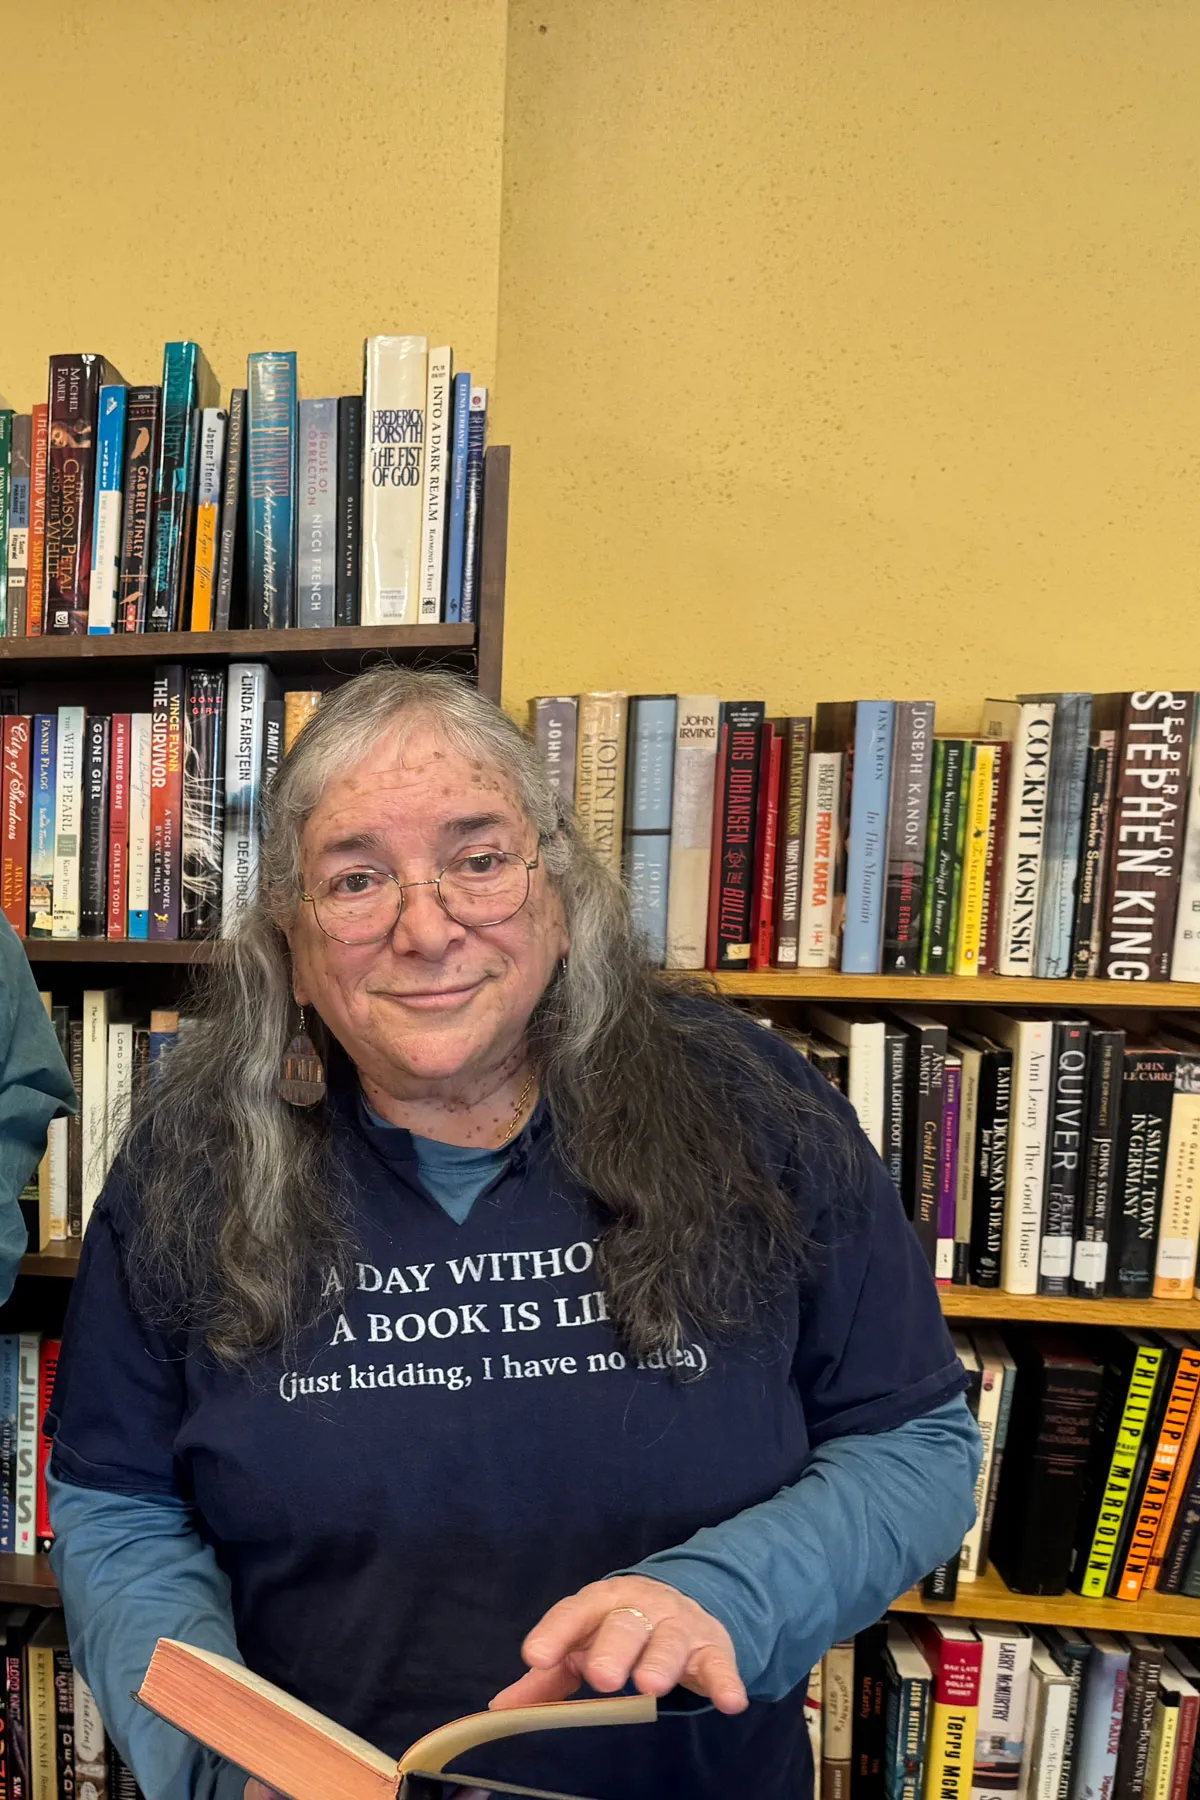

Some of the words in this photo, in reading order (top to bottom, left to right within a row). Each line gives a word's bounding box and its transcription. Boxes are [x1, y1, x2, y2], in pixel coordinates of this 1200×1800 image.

[56, 367, 68, 403] FABER
[69, 367, 81, 412] MICHEL
[432, 384, 443, 419] INTO
[229, 395, 241, 454] ANTONIA
[372, 409, 423, 425] FREDERICK
[372, 425, 423, 443] FORSYTH
[432, 422, 441, 431] A
[204, 427, 217, 460] Jasper
[371, 447, 395, 466] THE
[398, 447, 422, 466] FIST
[430, 435, 441, 472] DARK
[51, 466, 61, 493] AND
[135, 465, 149, 514] GABRIEL
[204, 462, 215, 494] Fforde
[226, 459, 238, 506] FRASER
[372, 467, 389, 486] OF
[391, 466, 419, 486] GOD
[50, 496, 61, 519] THE
[61, 459, 79, 538] CRIMSON
[428, 477, 440, 521] REALM
[47, 520, 61, 579] WHITE
[133, 519, 147, 559] FINLEY
[311, 514, 322, 553] NICCI
[59, 543, 76, 594] PETAL
[310, 558, 322, 611] FRENCH
[153, 678, 168, 707] THE
[169, 694, 180, 731] VINCE
[239, 675, 254, 713] LINDA
[5, 723, 27, 759] City
[40, 719, 51, 755] FANNIE
[116, 722, 124, 734] AN
[266, 720, 279, 764] FAMILY
[680, 728, 716, 738] IRVING
[682, 716, 714, 726] JOHN
[909, 708, 927, 774] JOSEPH
[62, 733, 75, 780] WHITE
[92, 723, 102, 764] GONE
[114, 736, 124, 781] UNMARKED
[151, 719, 168, 788] SURVIVOR
[168, 733, 180, 772] FLYNN
[234, 717, 252, 781] FAIRSTEIN
[732, 731, 755, 761] IRIS
[6, 761, 23, 777] of
[39, 757, 51, 790] FLAGG
[91, 769, 102, 800] GIRL
[1018, 719, 1051, 845] COCKPIT
[1116, 690, 1174, 873] STEPHEN
[1154, 700, 1187, 878] DESPERATION
[8, 779, 27, 841] Shadows
[62, 784, 74, 832] PEARL
[114, 784, 123, 810] GRAVE
[726, 767, 753, 844] JOHANSEN
[904, 783, 921, 846] KANON
[154, 825, 162, 838] BY
[154, 840, 162, 865] KYLE
[163, 818, 172, 848] MITCH
[815, 812, 832, 858] FRANZ
[3, 857, 13, 909] FRANKLIN
[14, 865, 23, 903] ARIANA
[112, 842, 122, 885] CHARLES
[163, 851, 171, 877] RAPP
[812, 861, 830, 907] KAFKA
[112, 888, 121, 915] TODD
[162, 878, 170, 910] NOVEL
[720, 887, 745, 941] BULLET
[1008, 853, 1038, 964] KOSINSKI
[1107, 890, 1156, 981] KING
[918, 1044, 932, 1096] LAMOTT
[931, 1052, 944, 1089] ANNE
[1028, 1050, 1045, 1081] Ann
[995, 1066, 1009, 1112] EMILY
[1022, 1088, 1042, 1130] Leary
[1052, 1050, 1086, 1170] QUIVER
[1131, 1114, 1146, 1131] IN
[989, 1118, 1007, 1192] DICKINSON
[1024, 1142, 1040, 1171] The
[1142, 1129, 1161, 1184] SMALL
[1022, 1176, 1038, 1215] Good
[1122, 1135, 1144, 1219] GERMANY
[989, 1197, 1003, 1210] IS
[1138, 1186, 1157, 1239] TOWN
[987, 1212, 1001, 1252] DEAD
[1019, 1221, 1037, 1268] House
[321, 1266, 343, 1296] A
[354, 1262, 435, 1294] DAY
[446, 1239, 599, 1284] WITHO
[329, 1313, 356, 1346] A
[367, 1305, 489, 1343] BOOK
[499, 1303, 540, 1332] IS
[279, 1371, 341, 1402] (just
[349, 1364, 473, 1392] kidding,
[482, 1357, 494, 1380] I
[501, 1353, 577, 1379] have
[586, 1353, 626, 1372] no
[1122, 1353, 1158, 1437] PHILLIP
[1163, 1356, 1199, 1440] PHILLIP
[19, 1356, 35, 1524] LESS
[1088, 1465, 1131, 1571] MARGOLIN
[1126, 1468, 1171, 1574] MARGOLIN
[997, 1642, 1017, 1671] LARRY
[36, 1653, 46, 1710] KRISTIN
[991, 1673, 1013, 1722] McMURTRY
[37, 1713, 48, 1768] HANNAH
[944, 1715, 966, 1759] Terry
